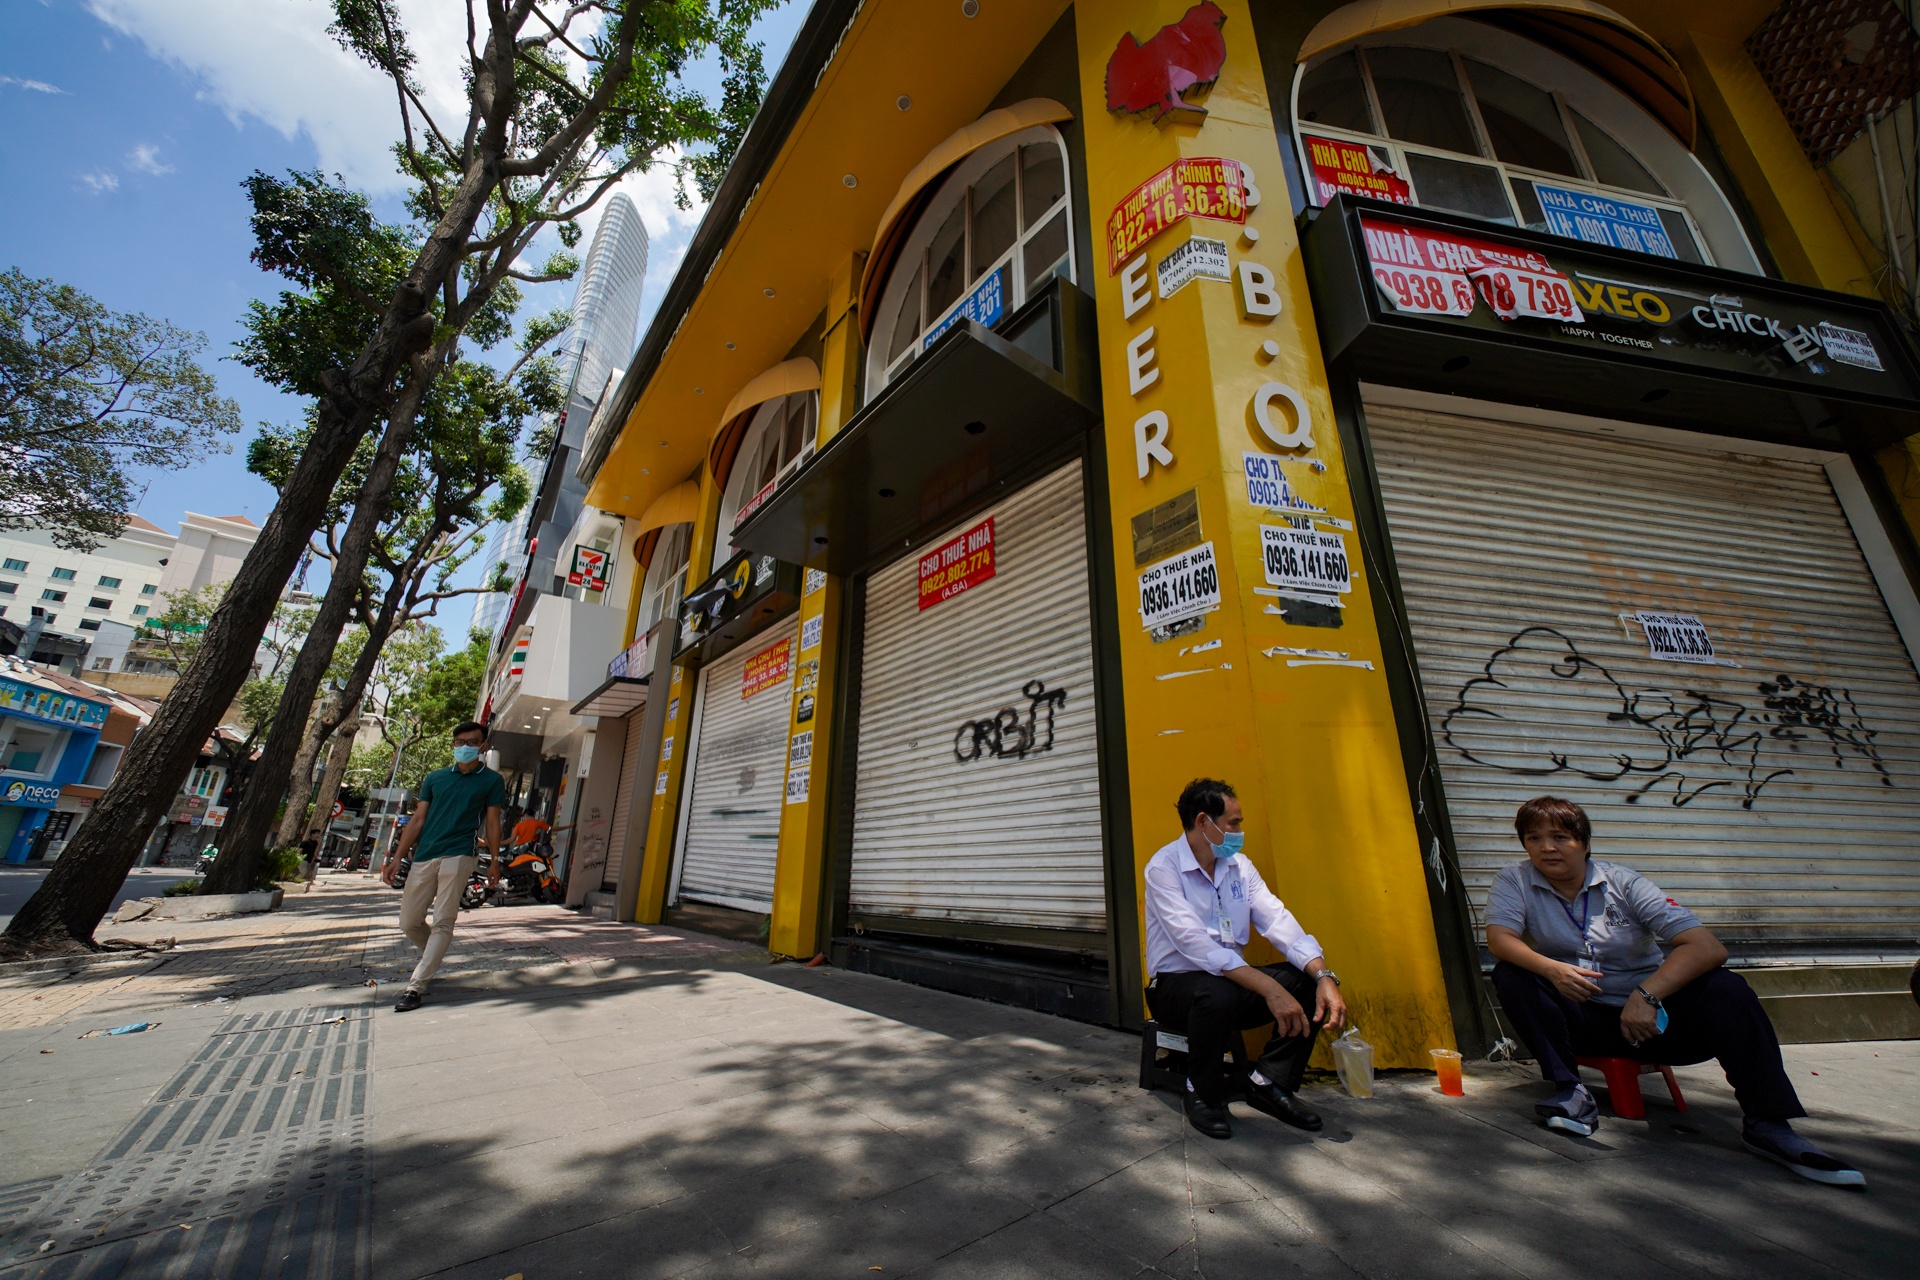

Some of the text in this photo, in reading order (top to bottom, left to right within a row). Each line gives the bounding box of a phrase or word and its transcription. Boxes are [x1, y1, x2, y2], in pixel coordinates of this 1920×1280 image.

[1312, 142, 1369, 174] NHÀ CHO
[1110, 210, 1122, 240] CHO
[1124, 185, 1148, 222] THUÊ
[1176, 162, 1212, 186] CHÍNH
[1214, 163, 1238, 186] CHỦ
[1541, 190, 1658, 226] NHÀ CHO THUÊ
[1194, 240, 1208, 253] CHO
[1209, 242, 1227, 257] THUÊ
[1365, 229, 1424, 267] NHÀ
[1427, 239, 1483, 271] CHO
[978, 273, 1000, 305] NHÀ
[1518, 276, 1572, 316] 739
[1560, 325, 1653, 350] HAPPY TOGETHER
[1246, 456, 1268, 479] CHO
[922, 523, 991, 578] CHO THUÊ NHÀ
[1264, 530, 1342, 549] CHO THUÊ NHÀ
[922, 549, 990, 596] 0922.802.774
[1142, 547, 1212, 584] CHO THUÊ NHÀ
[1266, 544, 1348, 583] 0936.141.660
[942, 579, 968, 599] (A.BA)
[1142, 563, 1217, 616] 0936.141.660
[1642, 614, 1702, 627] CHO THUÊ NHÀ
[1648, 625, 1713, 656] 0922.16.36.36
